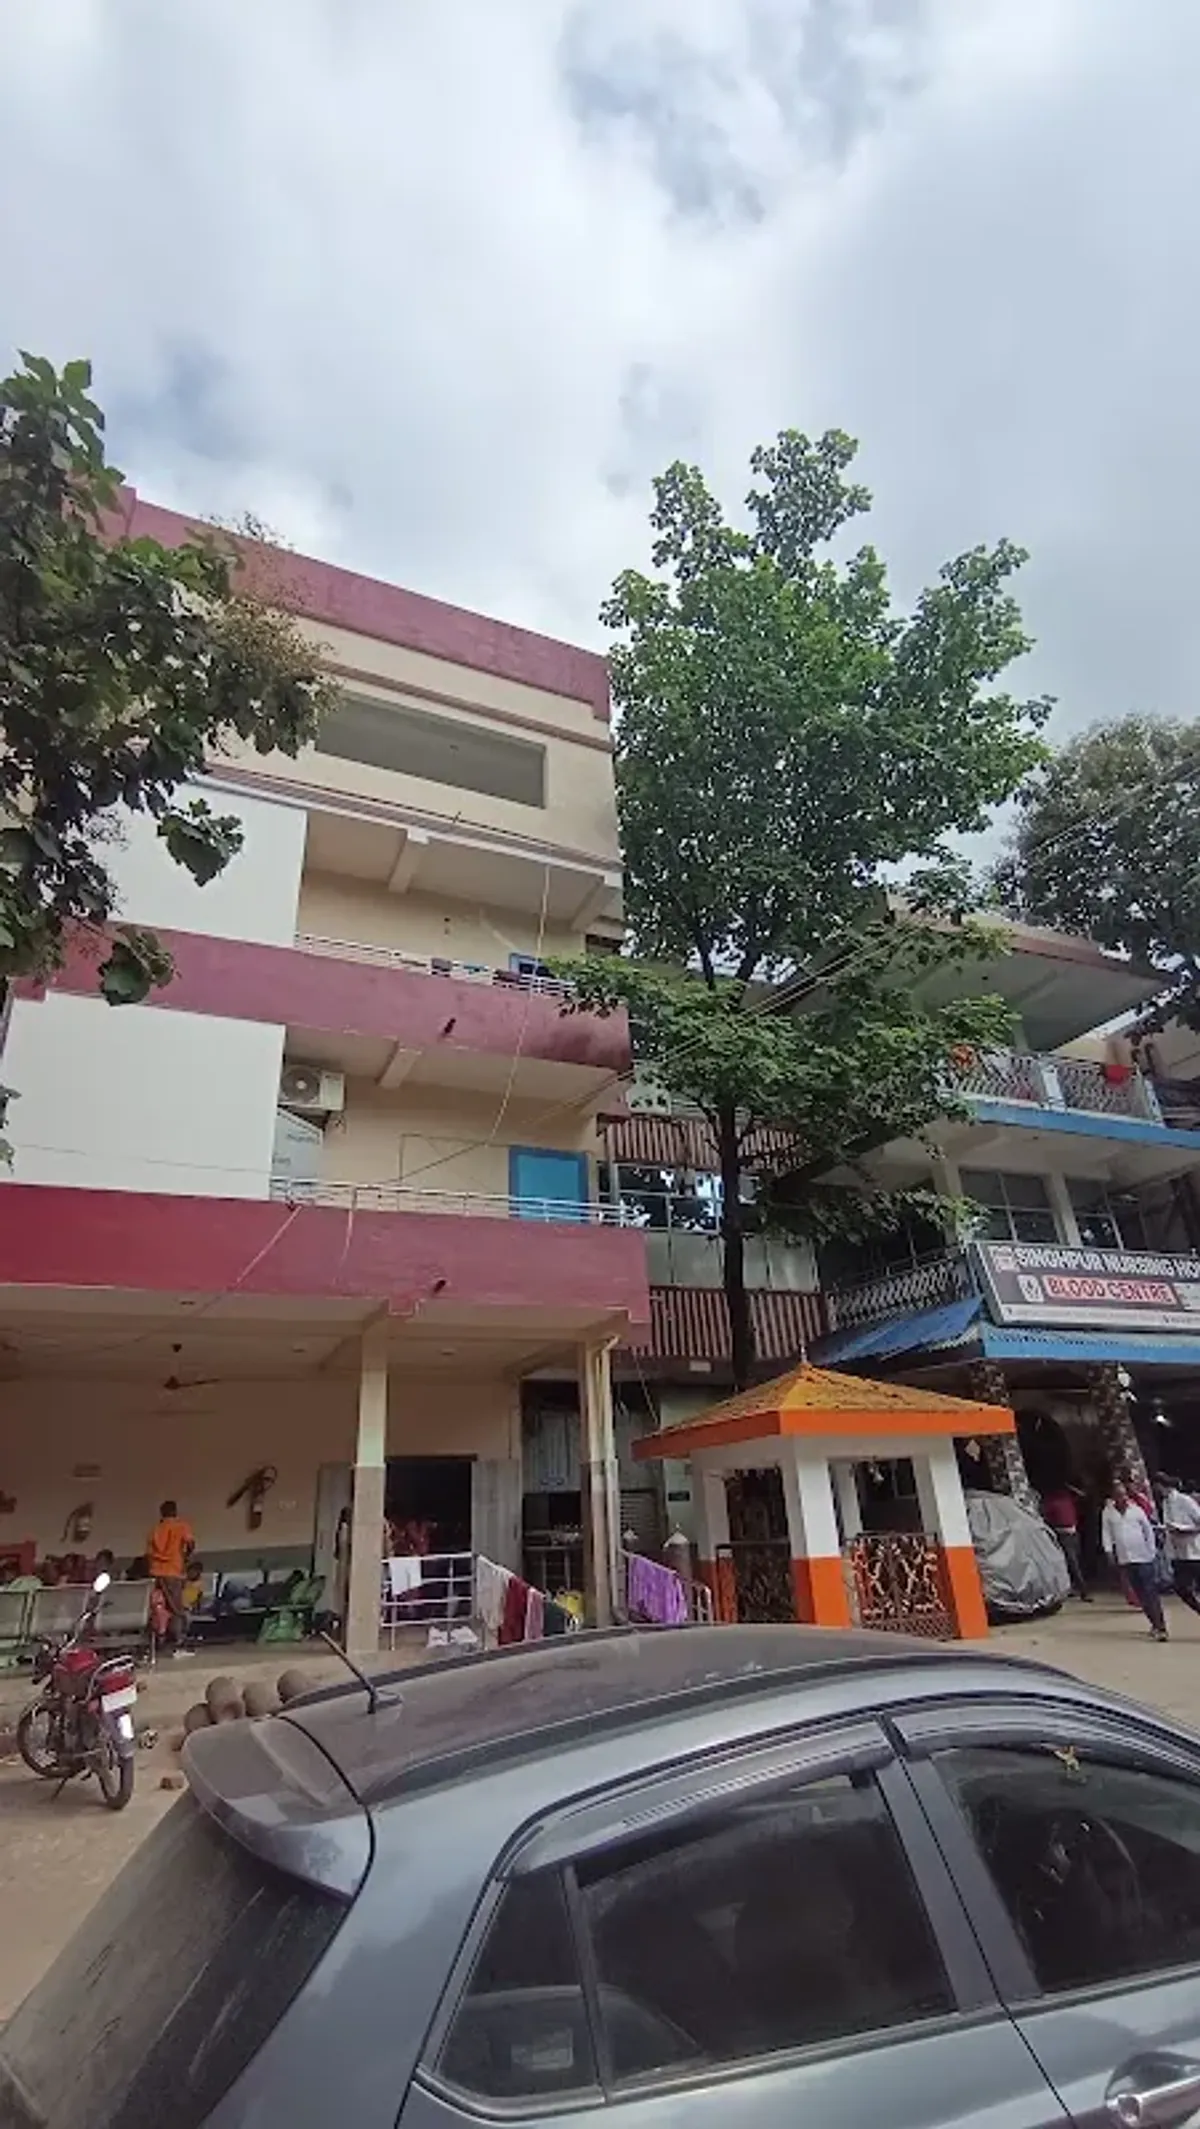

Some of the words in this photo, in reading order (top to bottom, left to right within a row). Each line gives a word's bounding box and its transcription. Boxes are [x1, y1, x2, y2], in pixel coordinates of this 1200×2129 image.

[1102, 1254, 1175, 1277] NURSING
[1048, 1277, 1106, 1298] BLOOD
[1107, 1283, 1173, 1303] CENTRE
